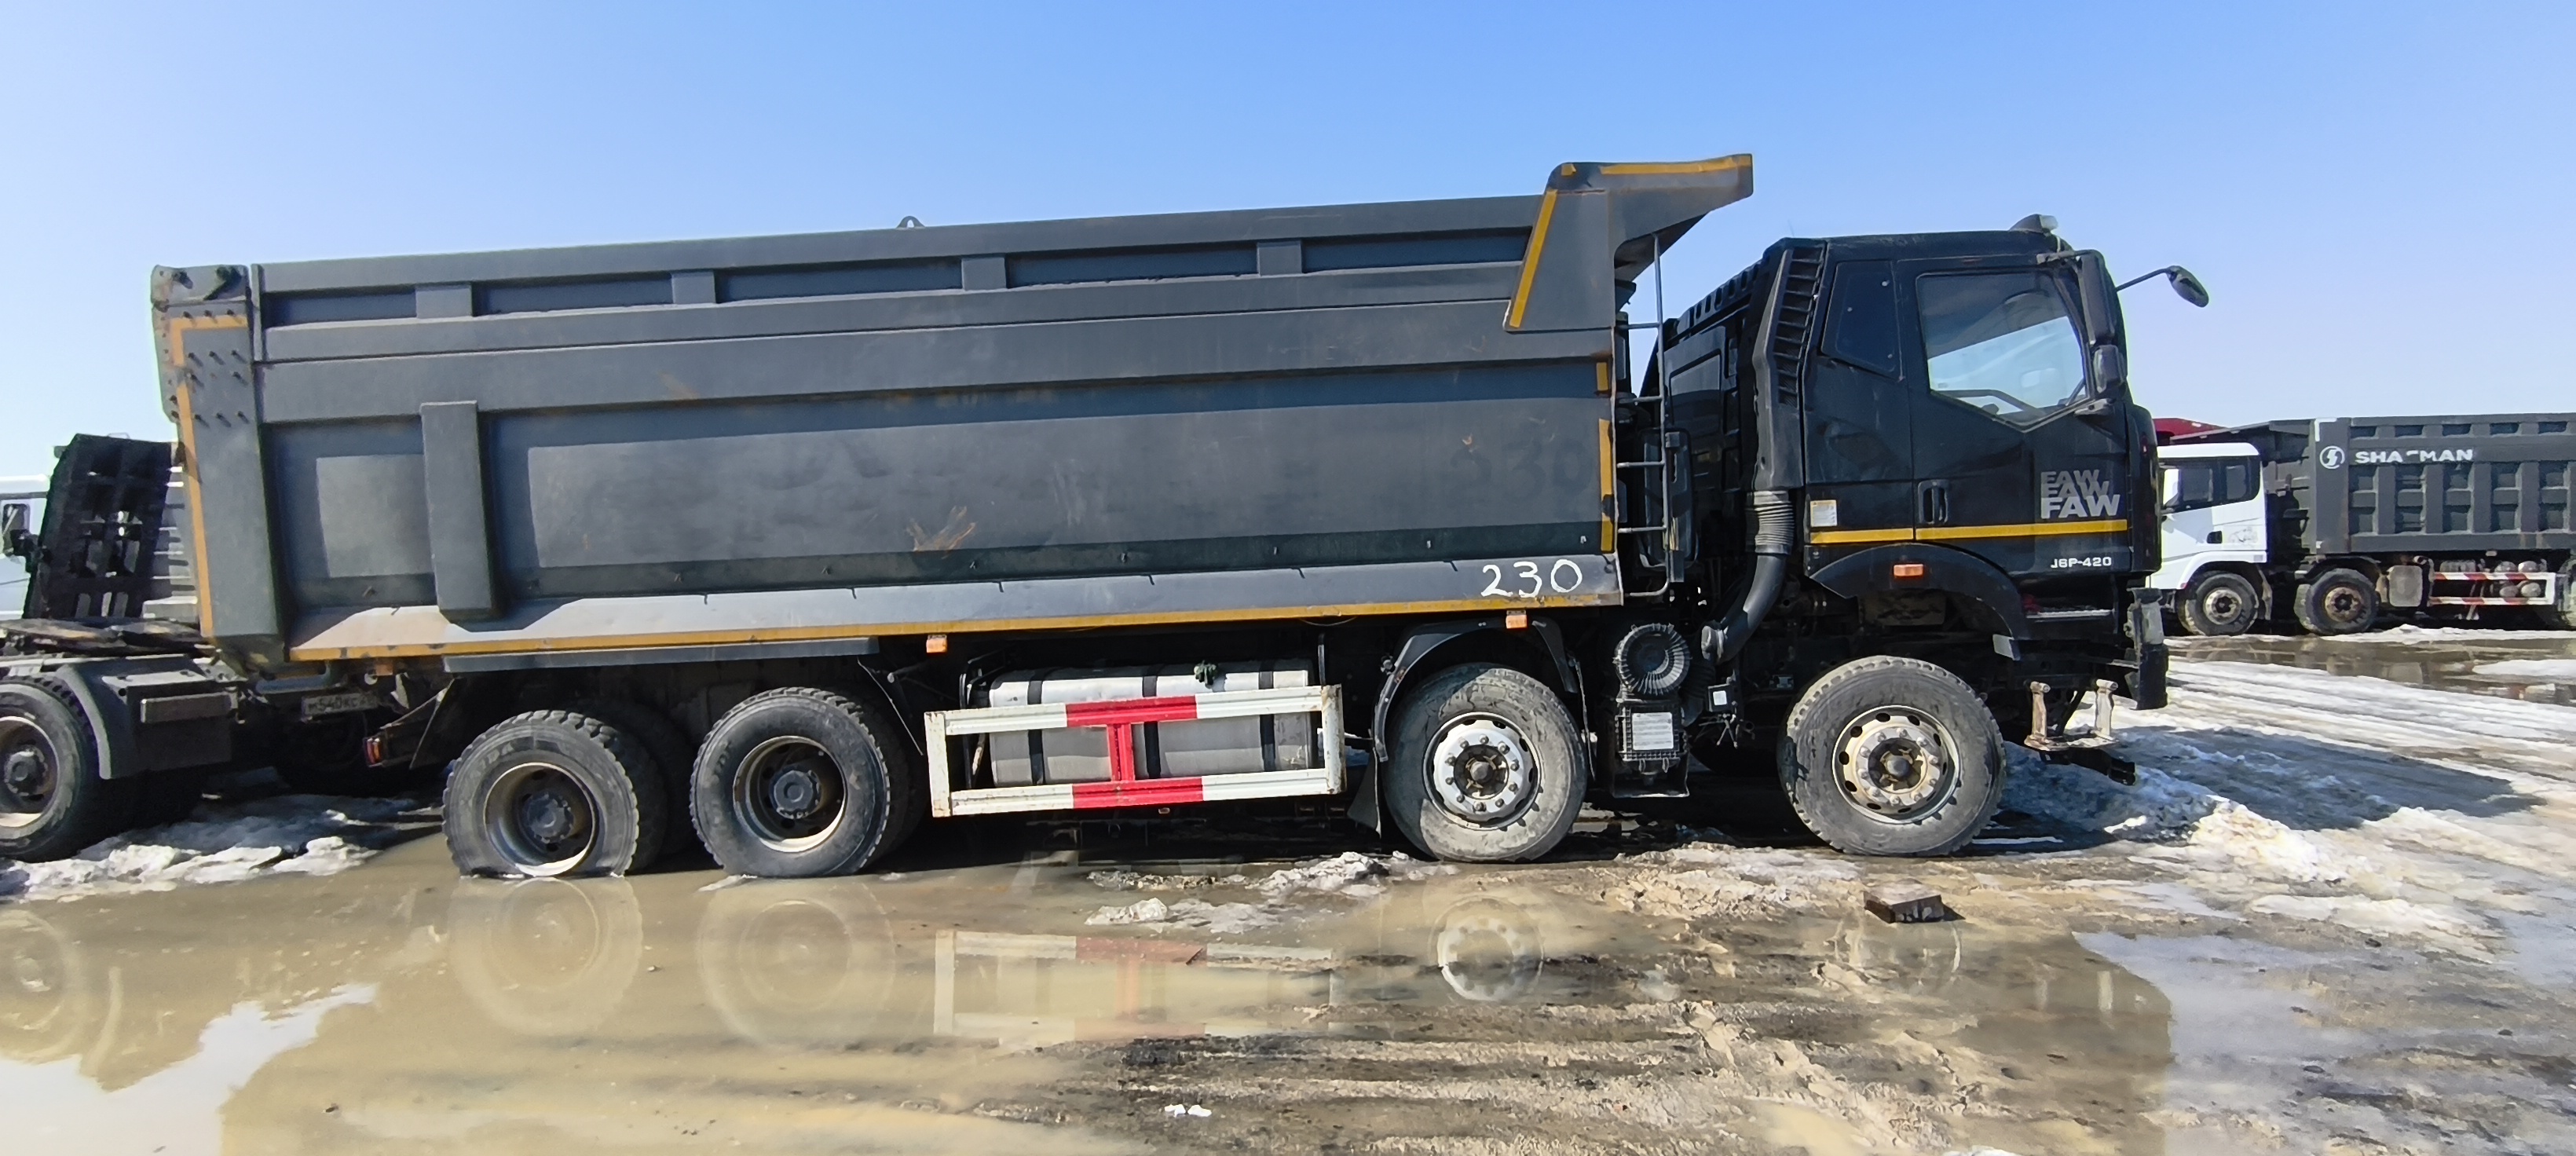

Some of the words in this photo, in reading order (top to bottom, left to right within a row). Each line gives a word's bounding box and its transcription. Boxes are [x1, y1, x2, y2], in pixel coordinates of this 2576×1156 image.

[2041, 494, 2120, 519] FAW
[2051, 556, 2112, 569] J6P-420
[1480, 558, 1583, 598] 230
